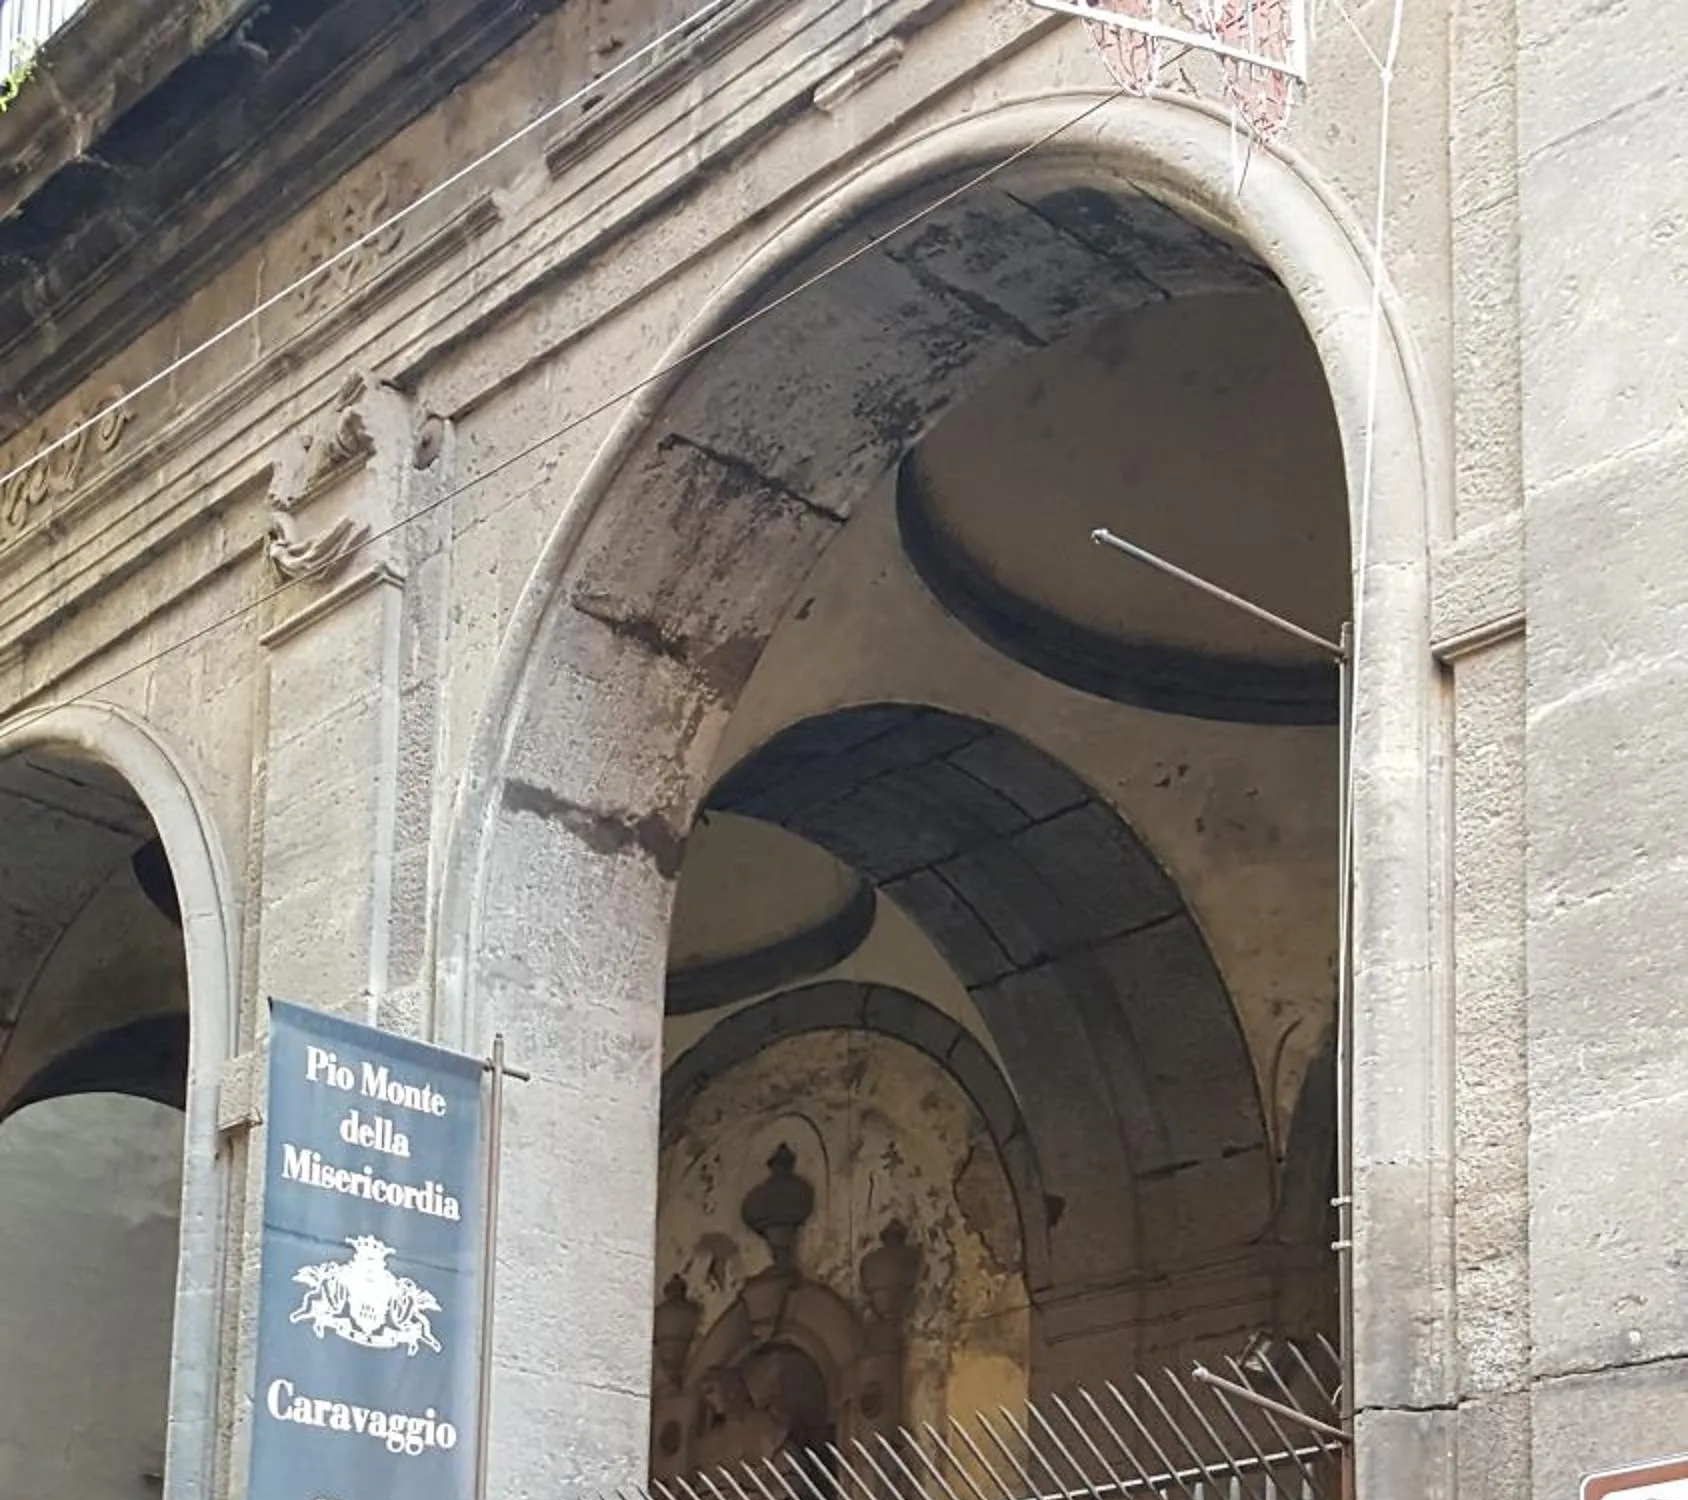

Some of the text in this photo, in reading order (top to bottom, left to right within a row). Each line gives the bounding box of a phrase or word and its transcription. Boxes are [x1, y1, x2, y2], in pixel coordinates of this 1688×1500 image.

[305, 1045, 448, 1119] Pio Monte
[339, 1109, 411, 1159] della
[281, 1143, 461, 1222] Misericordia
[266, 1378, 458, 1456] Caravaggio
